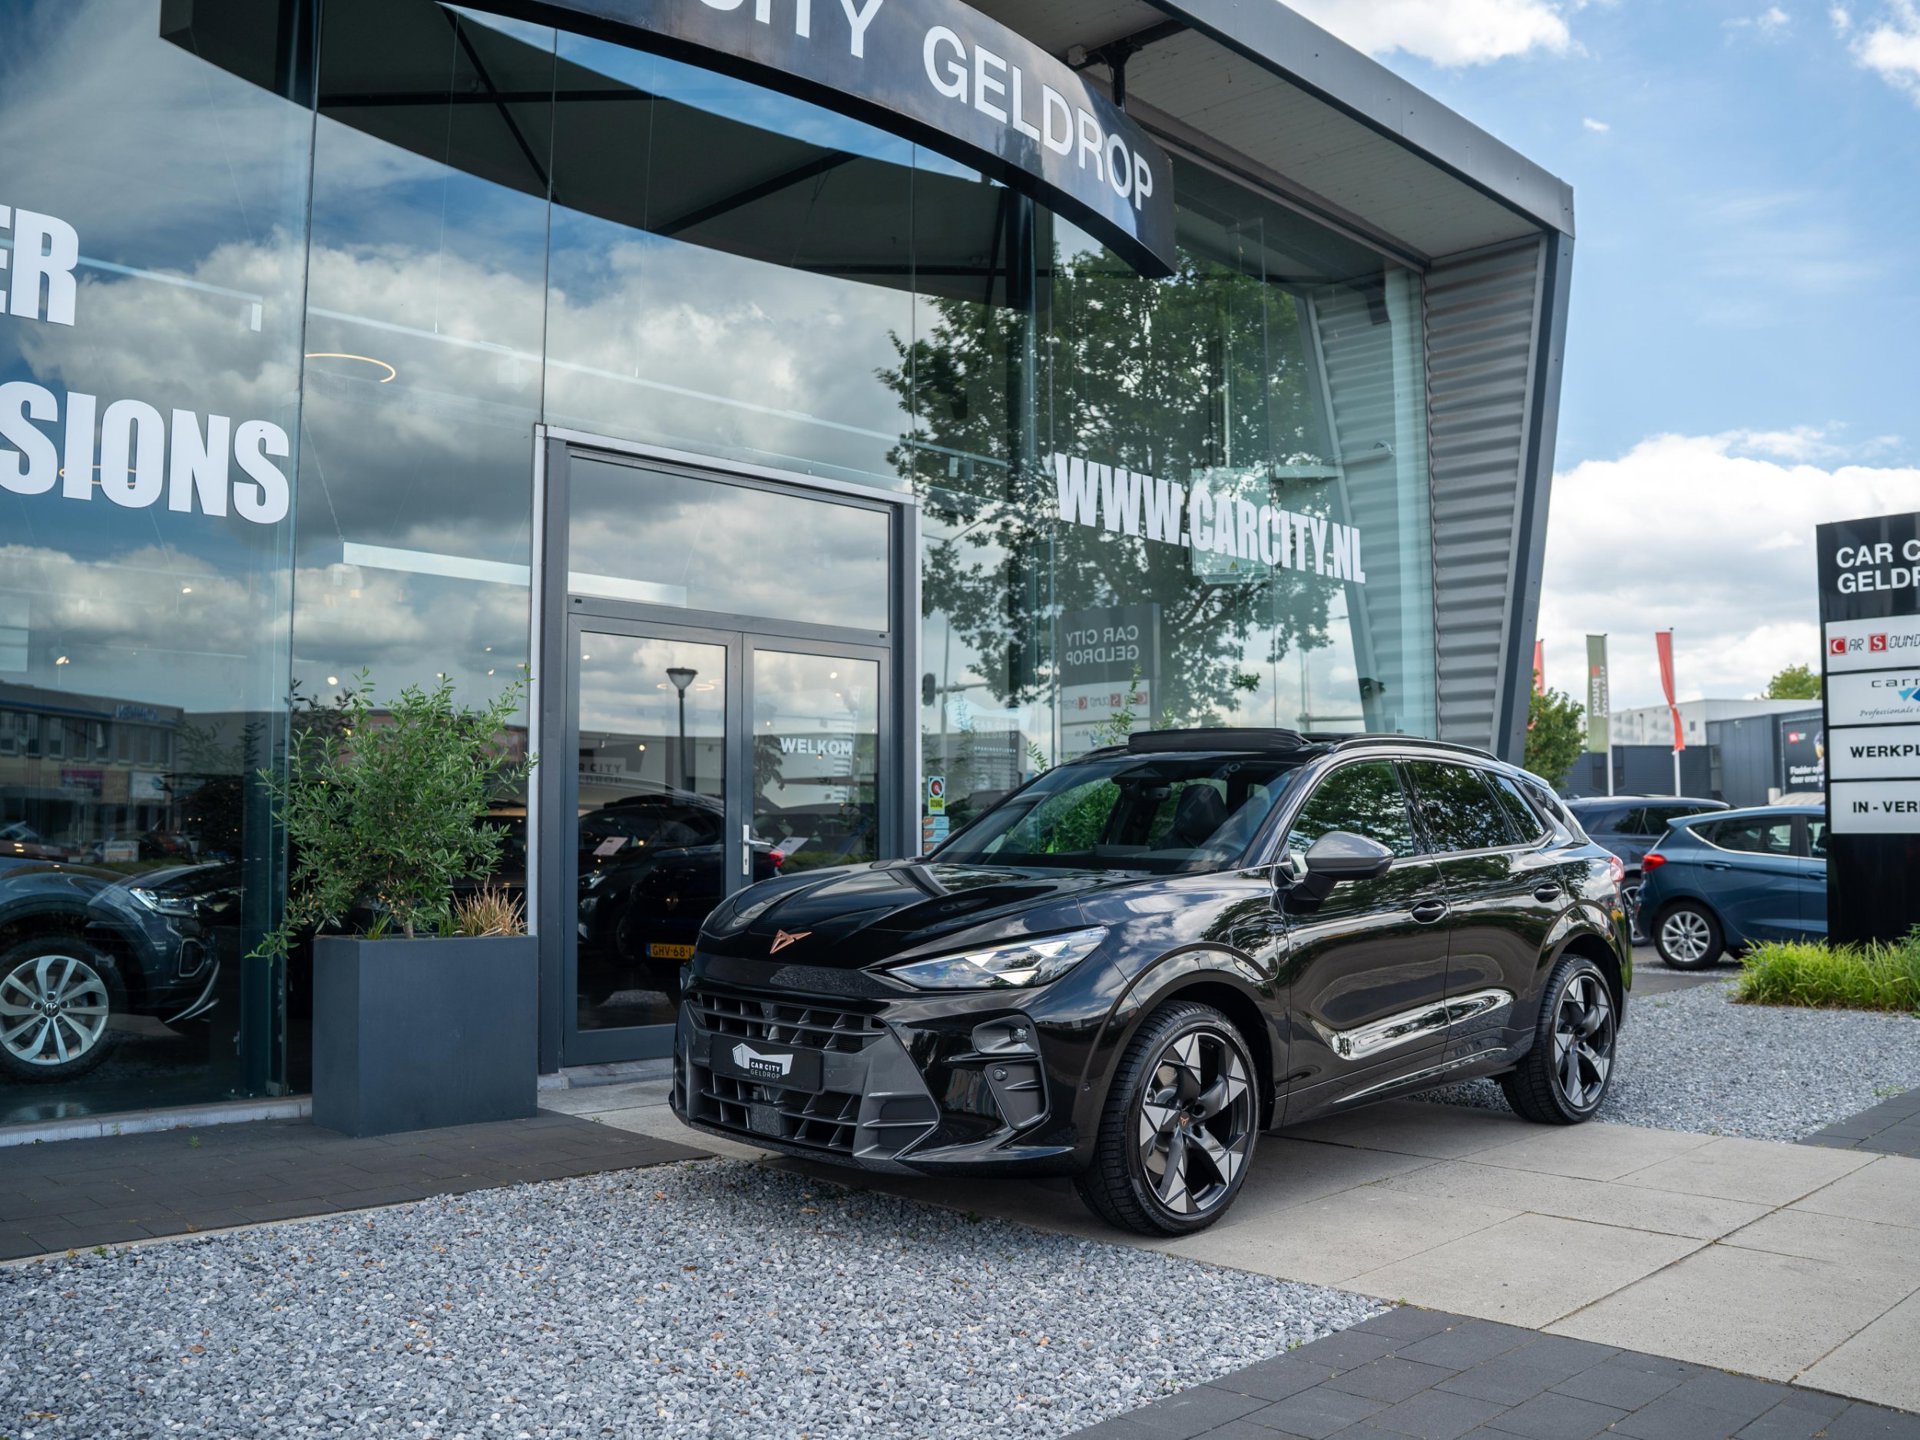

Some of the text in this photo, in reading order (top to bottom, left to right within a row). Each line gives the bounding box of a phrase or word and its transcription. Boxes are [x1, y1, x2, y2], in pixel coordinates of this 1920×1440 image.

[923, 25, 1153, 211] GELDROP
[0, 203, 79, 326] R
[0, 381, 289, 524] SIONS
[1054, 452, 1366, 584] WWW.CARCITY.NL
[1836, 543, 1893, 568] CAR
[1830, 638, 1864, 653] CAR
[780, 737, 853, 756] WELKOM
[1853, 801, 1868, 813] IN
[1882, 801, 1920, 813] VER
[750, 1061, 781, 1072] CAR CITY
[750, 1068, 781, 1079] GELDROP
